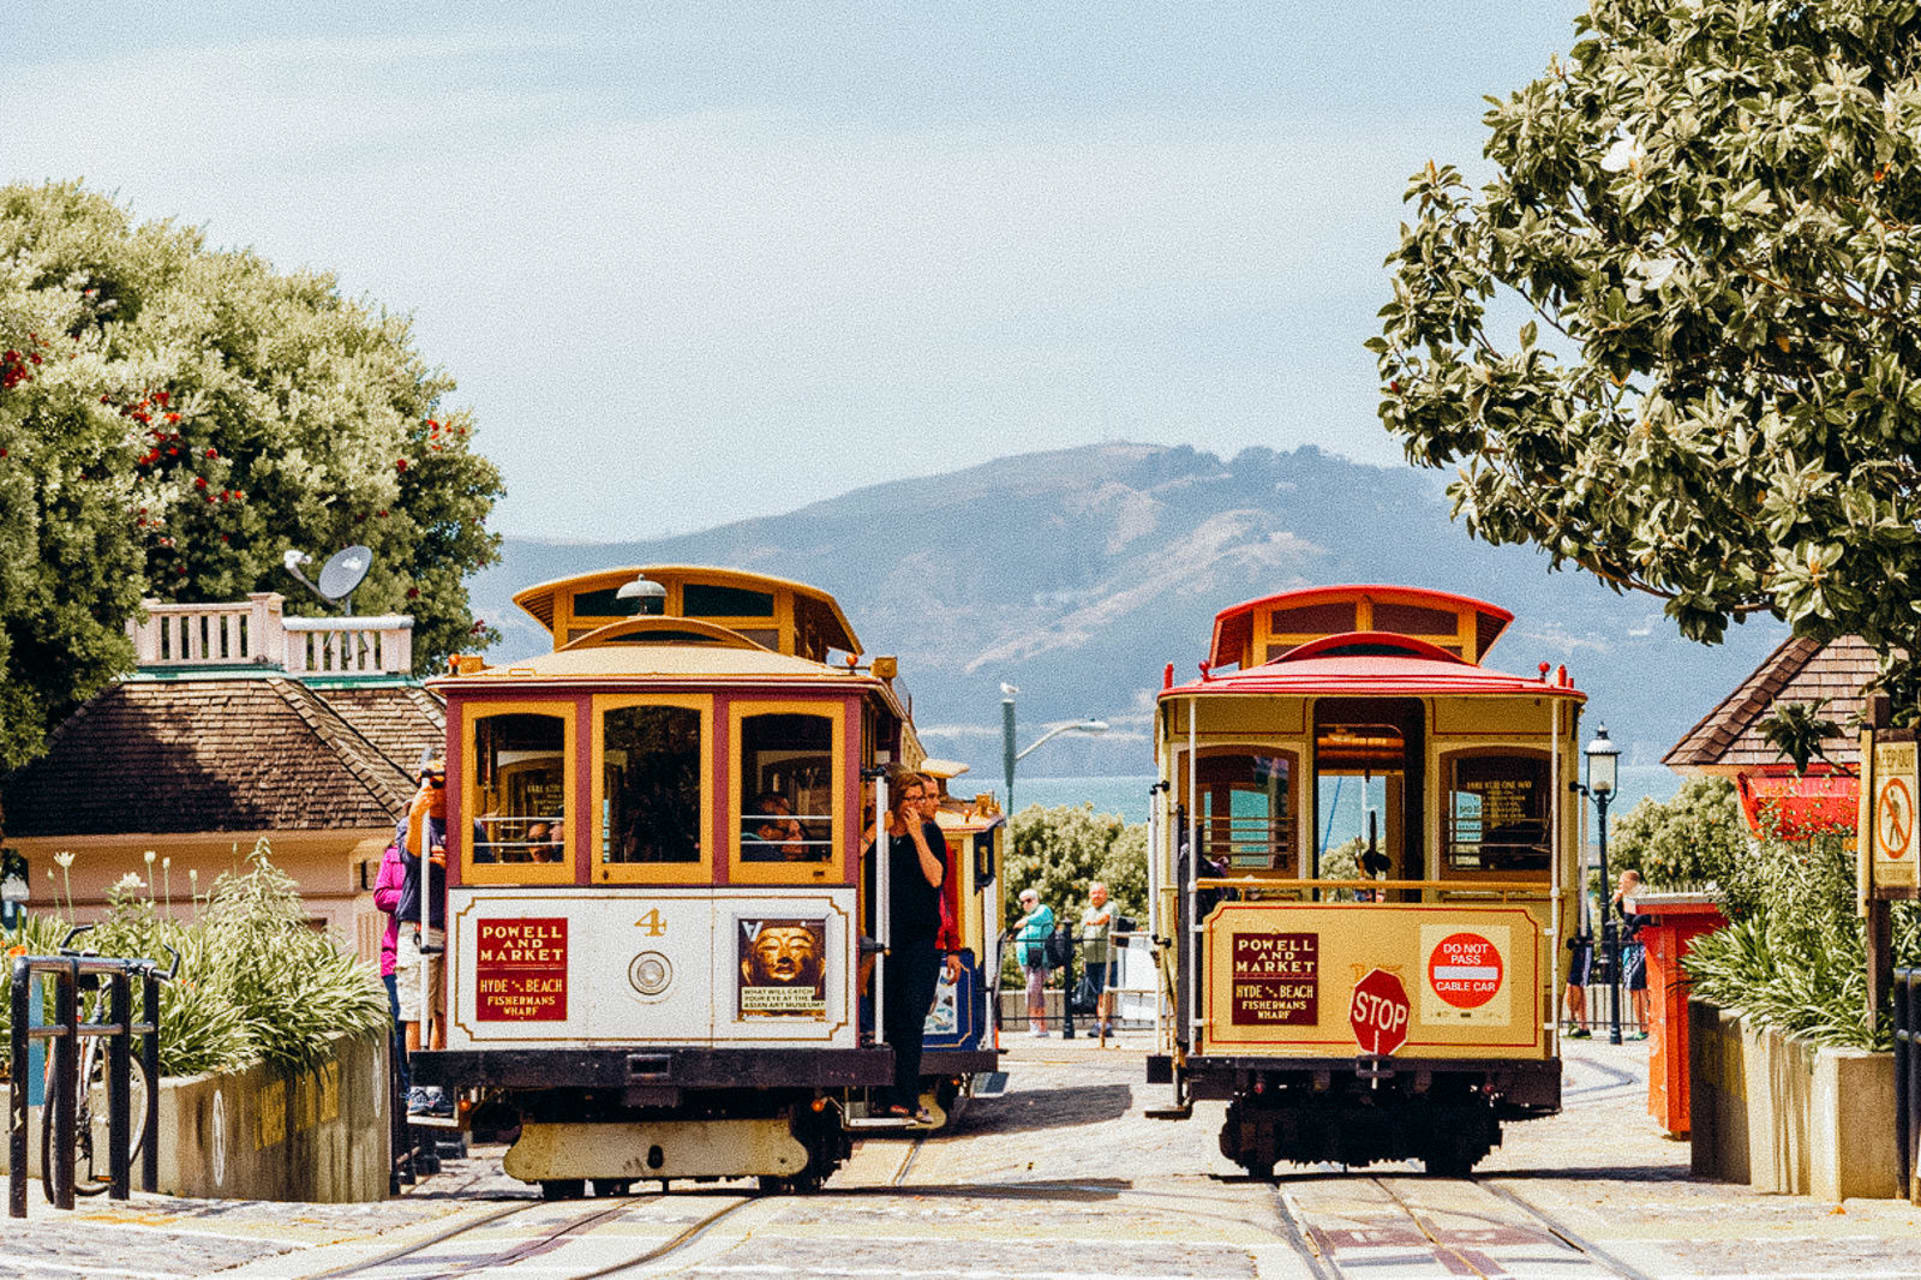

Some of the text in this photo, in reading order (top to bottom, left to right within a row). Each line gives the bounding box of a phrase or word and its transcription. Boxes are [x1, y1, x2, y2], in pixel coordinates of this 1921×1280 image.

[634, 907, 667, 937] 4
[482, 926, 563, 939] POWELL
[503, 938, 543, 949] AND
[1238, 939, 1314, 952] POWELL
[1443, 943, 1488, 954] DO NOT
[480, 948, 564, 961] MARKET
[1257, 951, 1295, 961] AND
[1451, 954, 1481, 965] PASS
[1236, 960, 1315, 973] MARKET
[480, 978, 508, 993] HYDE
[525, 978, 562, 993] BEACH
[1236, 984, 1263, 998] HYDE
[1279, 984, 1314, 999] BEACH
[1435, 981, 1496, 992] CABLE CAR
[503, 1005, 540, 1017] WHARF
[1257, 1010, 1291, 1020] WHARF
[1353, 991, 1407, 1034] STOP
